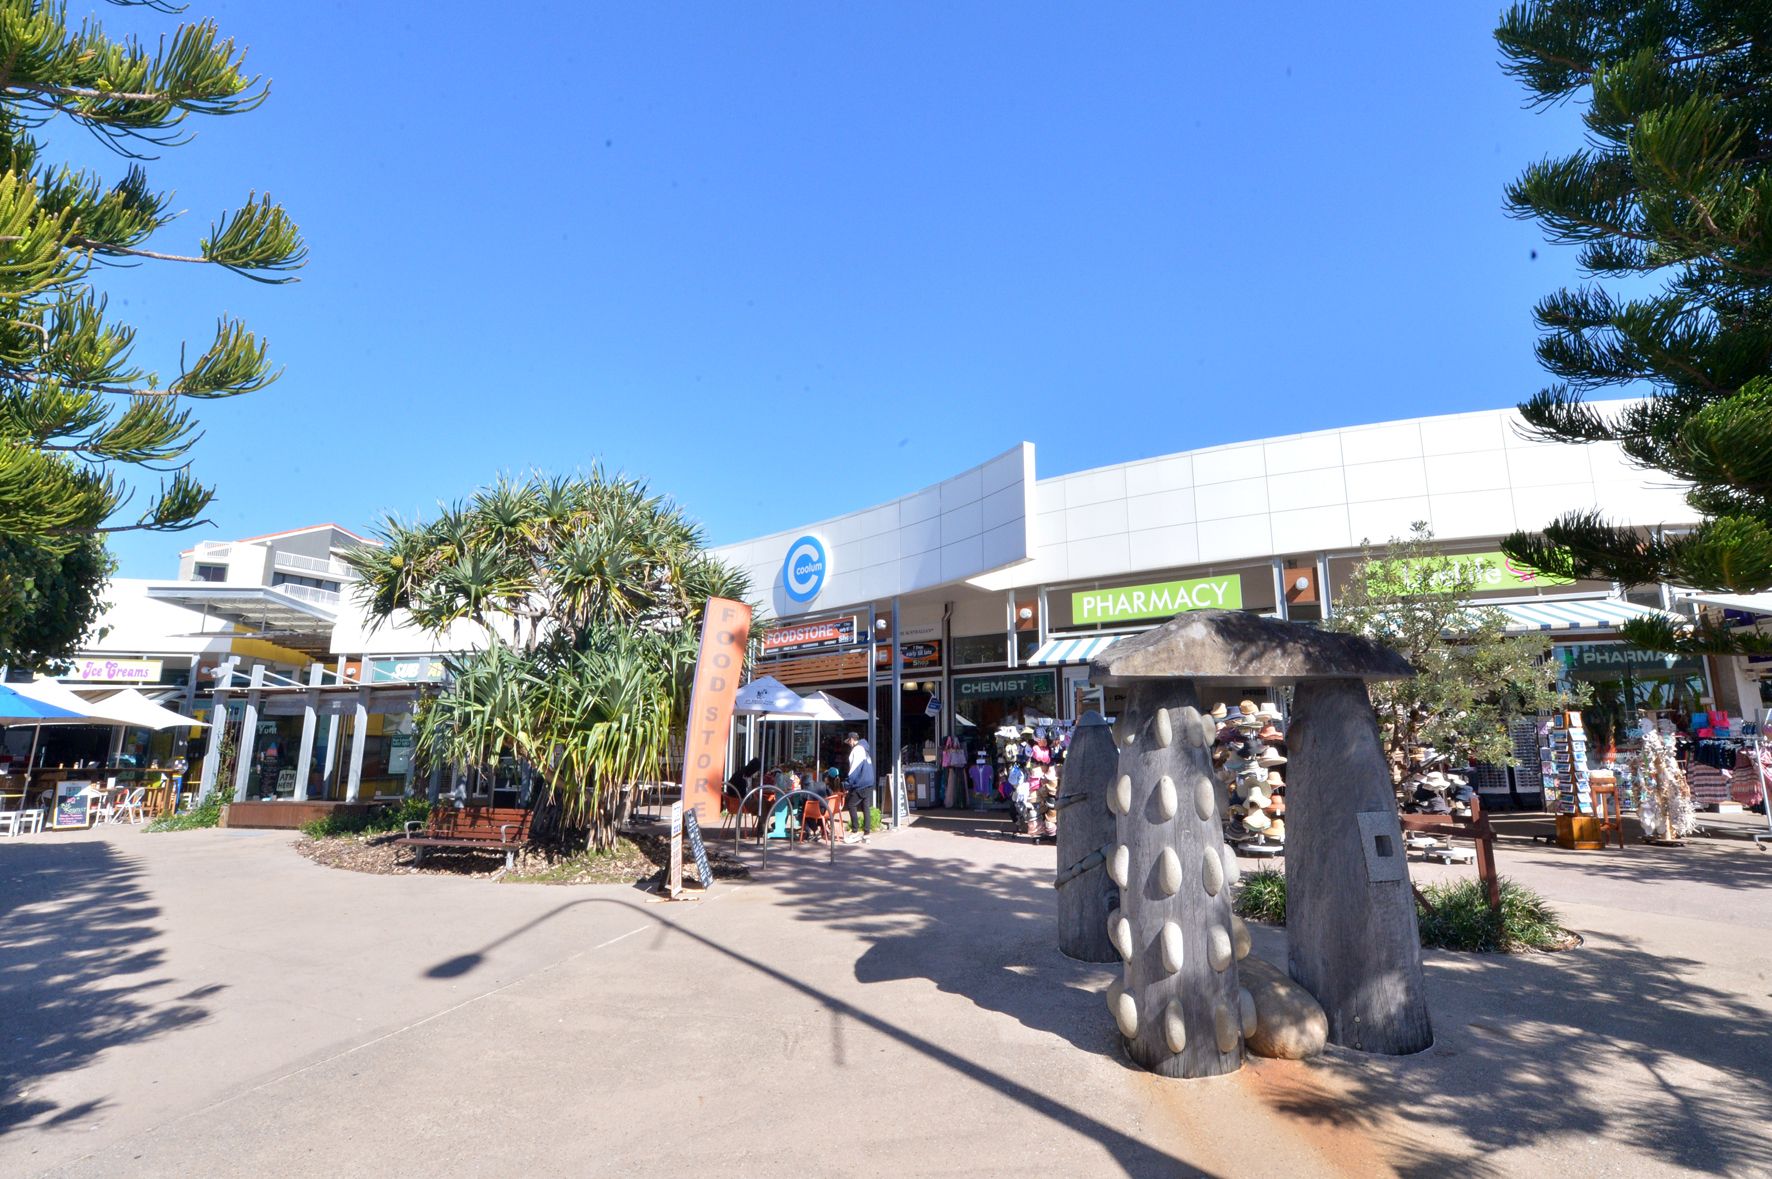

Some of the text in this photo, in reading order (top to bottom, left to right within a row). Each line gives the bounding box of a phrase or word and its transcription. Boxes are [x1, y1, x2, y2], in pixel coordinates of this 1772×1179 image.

[796, 562, 823, 576] coolum
[1082, 581, 1229, 619] PHARMACY
[767, 624, 834, 645] FOODSTORE
[710, 607, 737, 692] FOOD
[82, 661, 149, 679] Ice Creams
[961, 679, 1028, 694] CHEMIST
[694, 706, 719, 819] STORE
[279, 773, 297, 781] ATM
